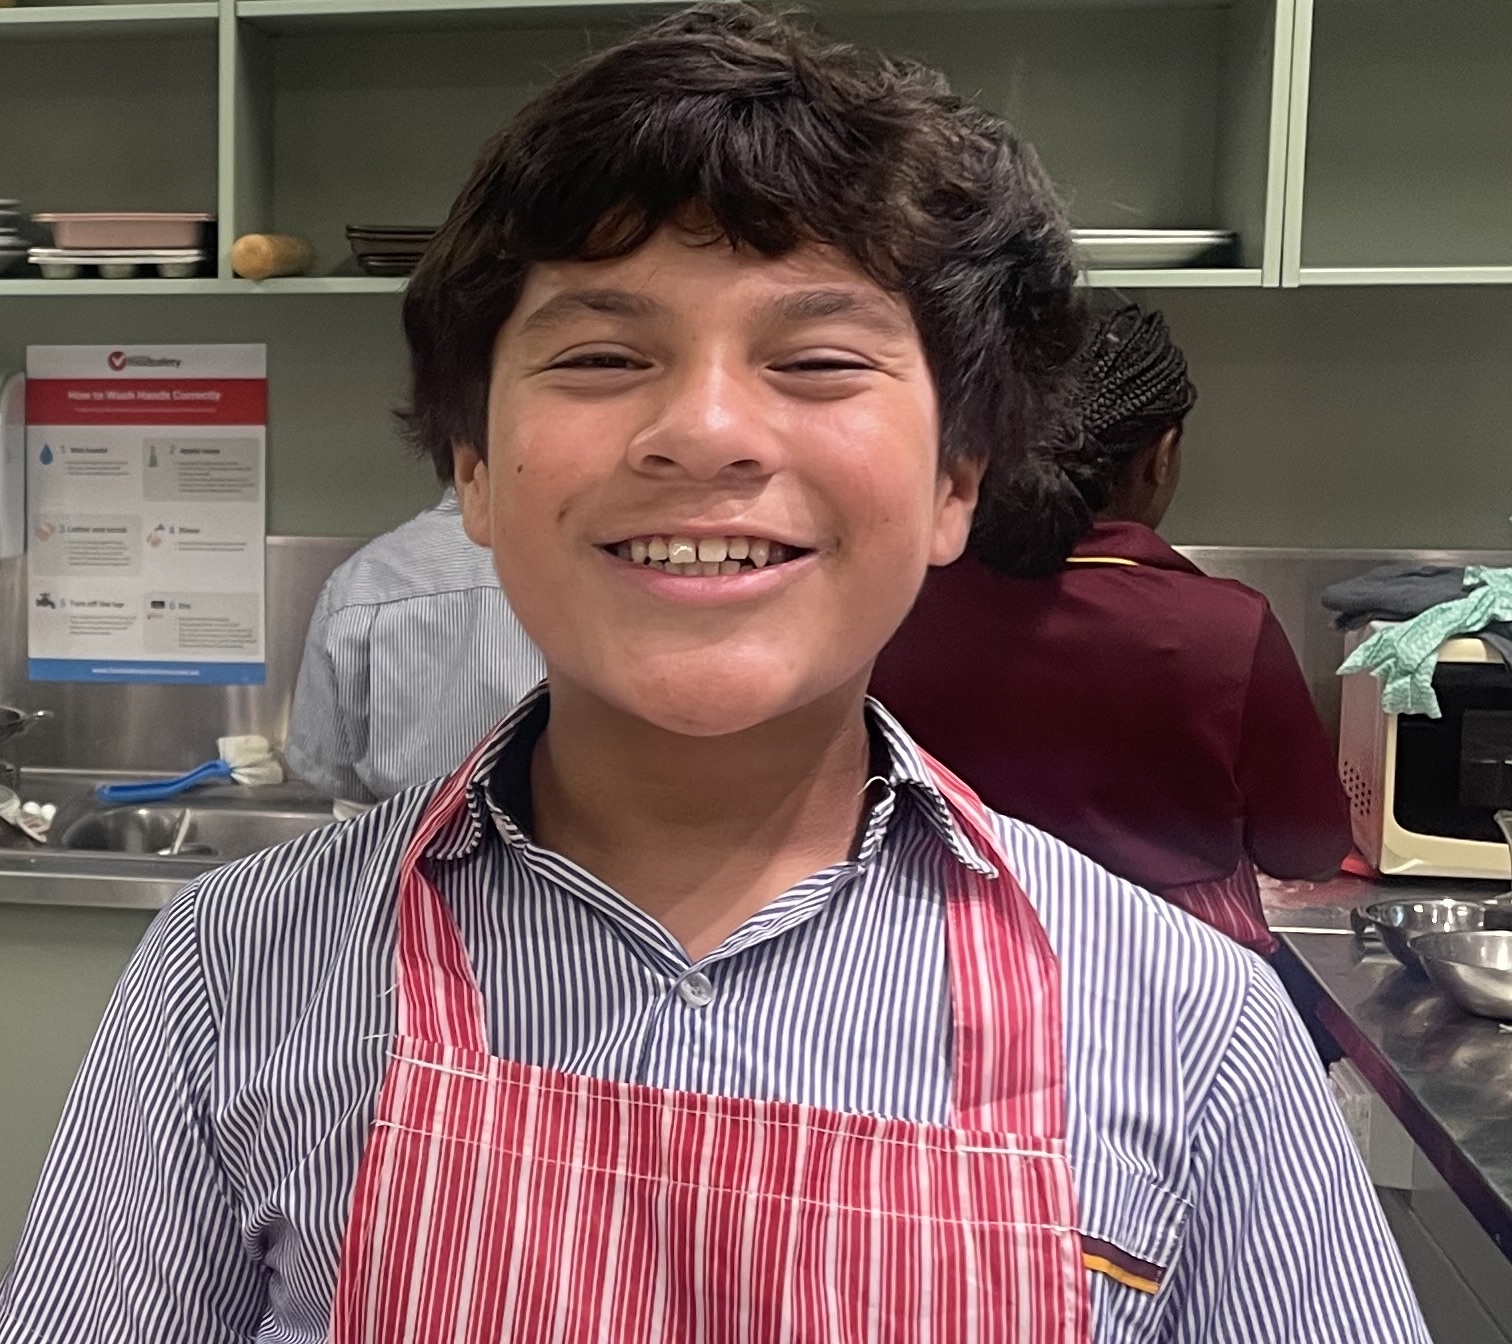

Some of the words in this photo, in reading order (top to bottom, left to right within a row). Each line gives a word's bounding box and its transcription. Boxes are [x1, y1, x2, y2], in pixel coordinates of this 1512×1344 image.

[106, 390, 135, 401] Wash
[137, 390, 170, 401] Hands
[172, 390, 221, 402] Correctly
